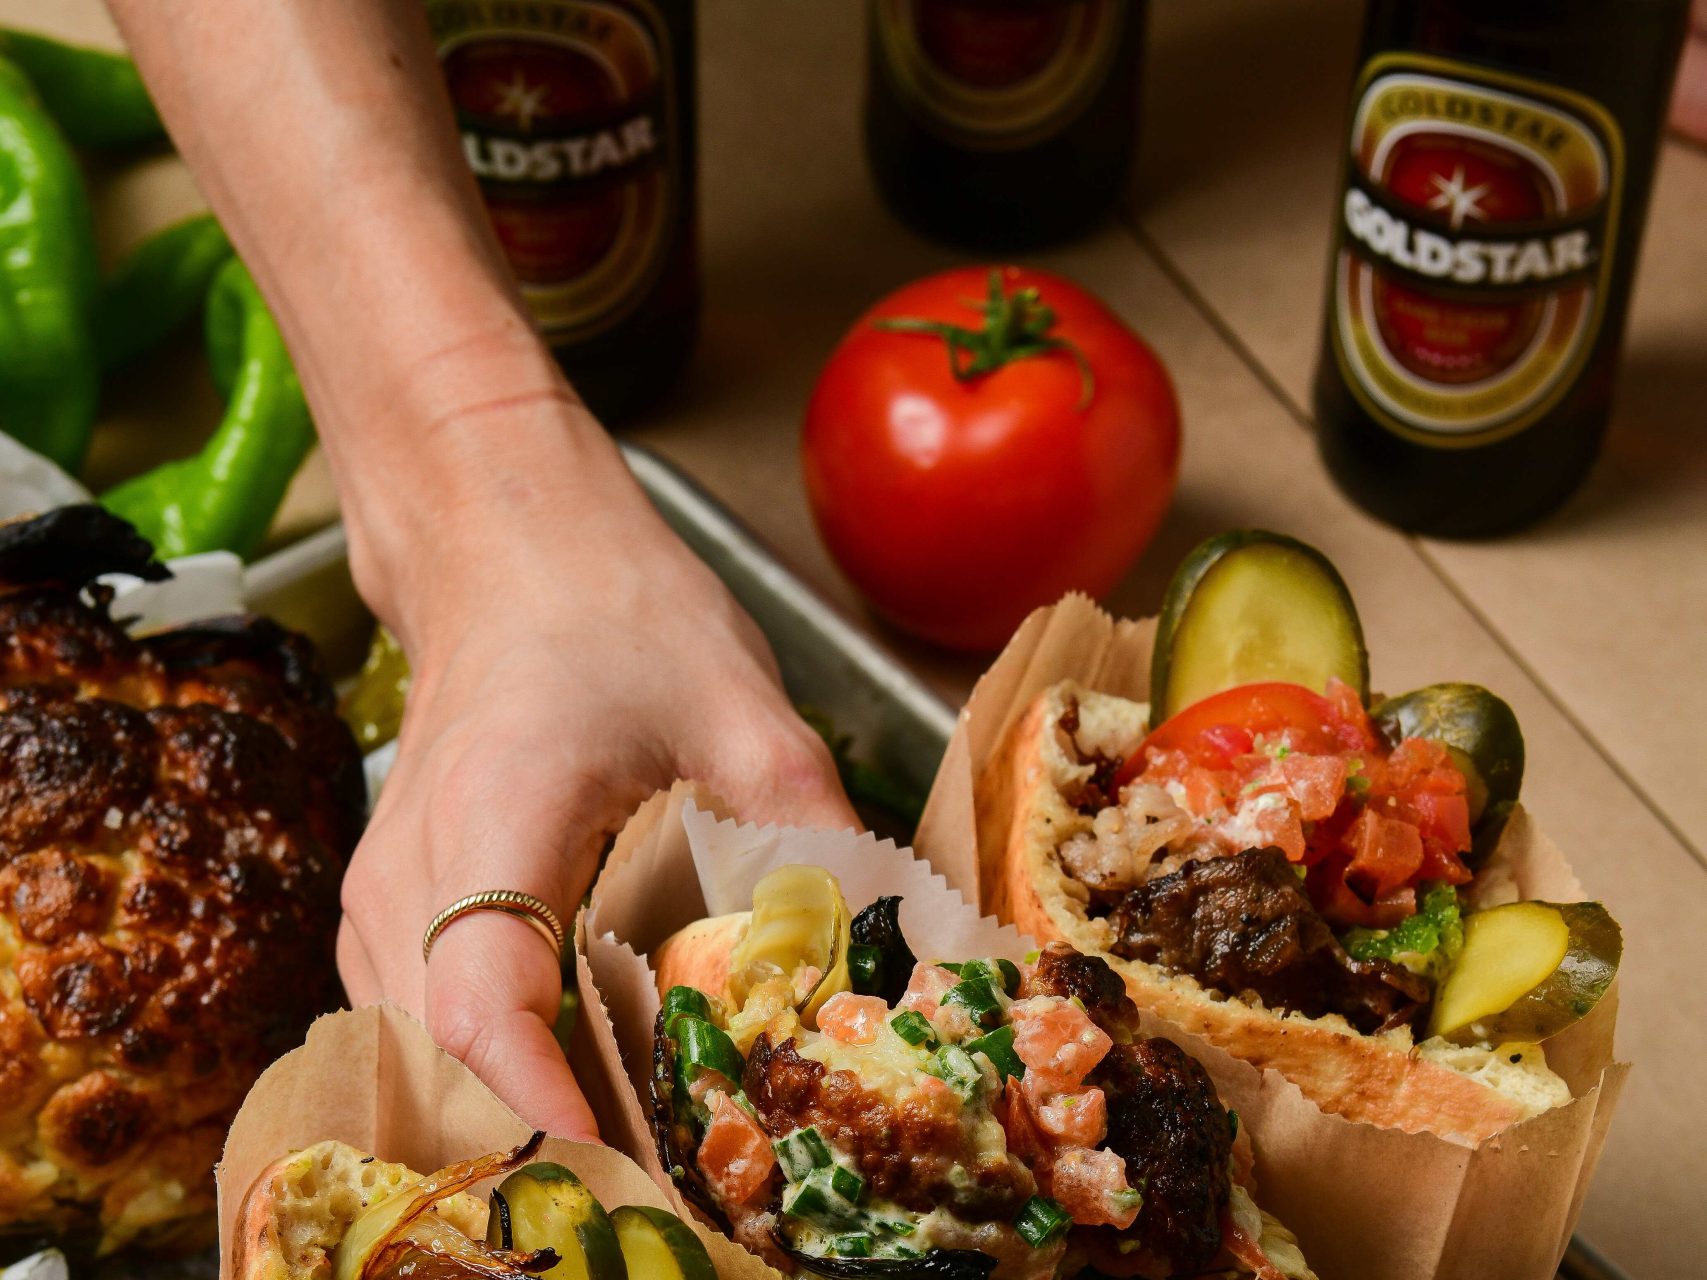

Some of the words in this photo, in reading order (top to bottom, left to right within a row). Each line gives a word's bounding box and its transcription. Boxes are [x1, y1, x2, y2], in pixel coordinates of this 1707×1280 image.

[461, 114, 656, 181] LDSTAR
[1380, 89, 1568, 152] GOLDSTAR
[1344, 188, 1590, 283] GOLDSTAR
